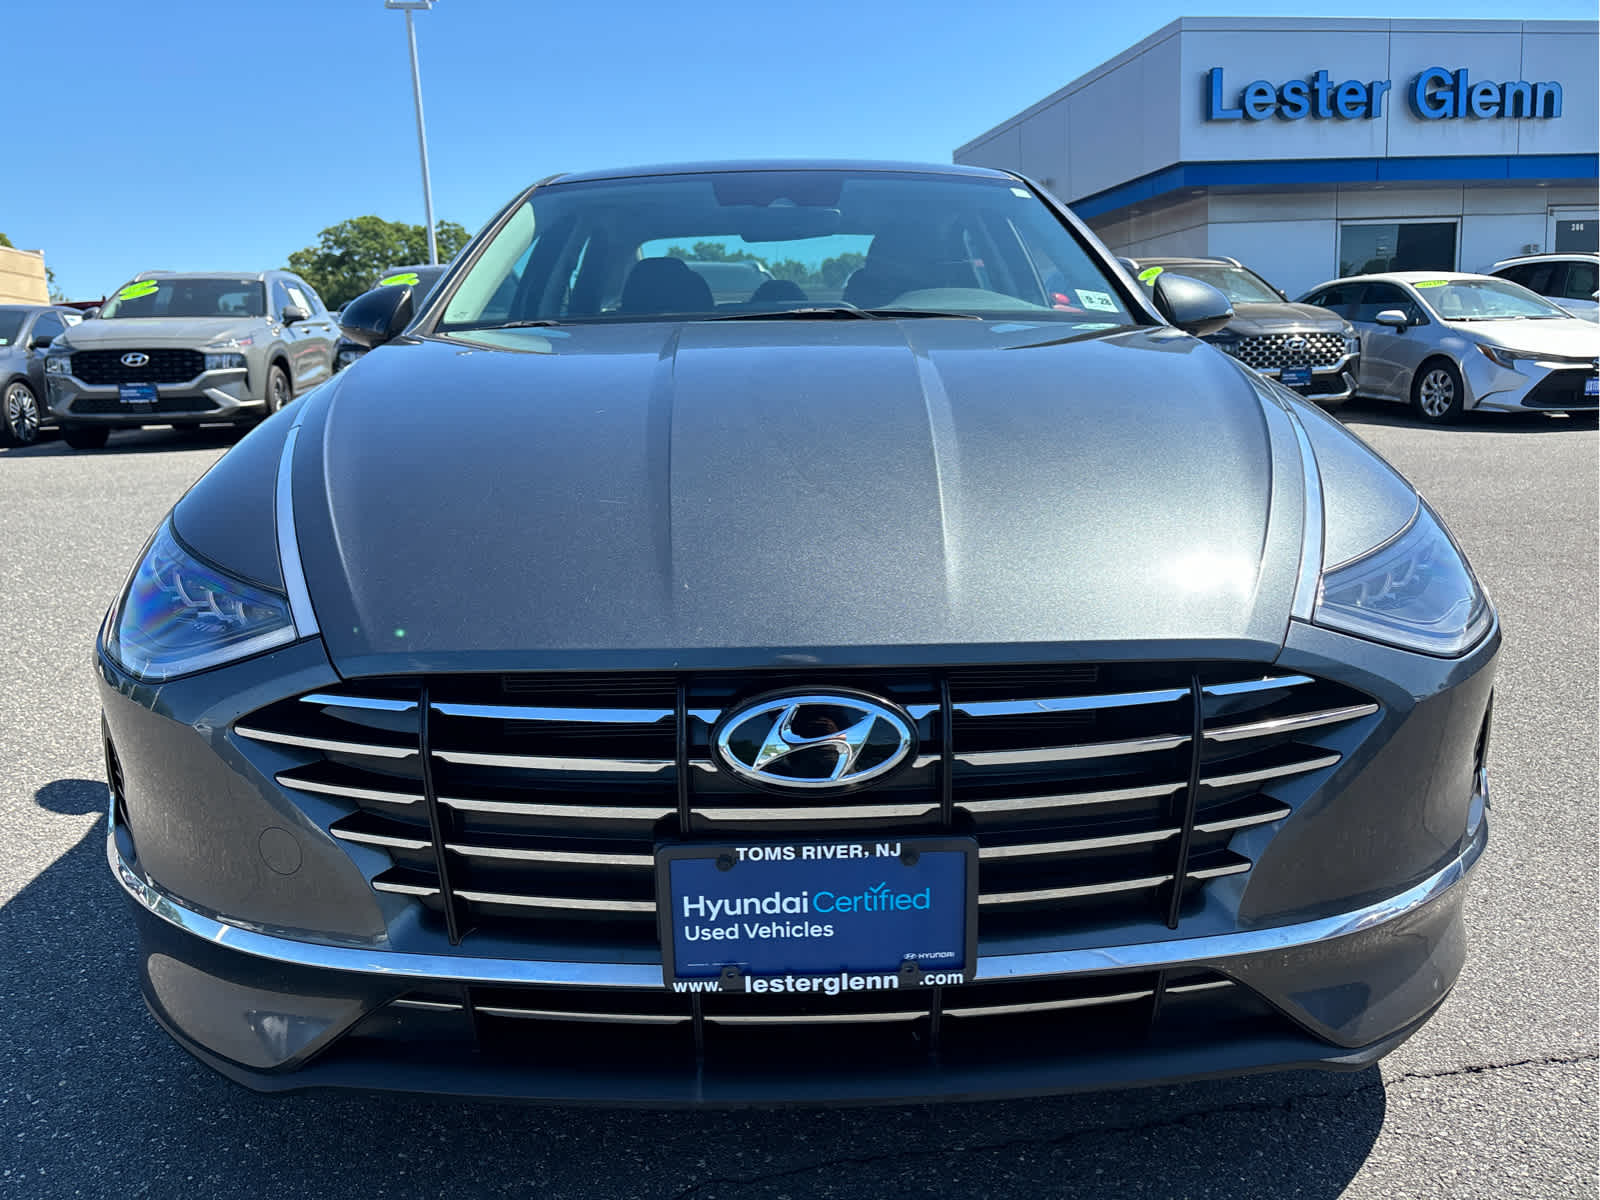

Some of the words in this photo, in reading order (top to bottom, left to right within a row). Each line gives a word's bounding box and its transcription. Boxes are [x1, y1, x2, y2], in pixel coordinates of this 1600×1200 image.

[1204, 67, 1391, 121] Lester
[1410, 66, 1563, 119] Glenn
[736, 846, 796, 861] TOMS
[802, 844, 869, 860] RIVER,
[876, 843, 902, 858] NJ
[682, 891, 809, 921] Hyundai
[812, 882, 931, 913] Certified
[684, 923, 740, 941] Used
[744, 921, 835, 939] Vehicles
[918, 951, 955, 959] HYUNDAI
[672, 980, 723, 993] www.
[745, 973, 899, 996] lesterglenn
[919, 971, 964, 986] .com
